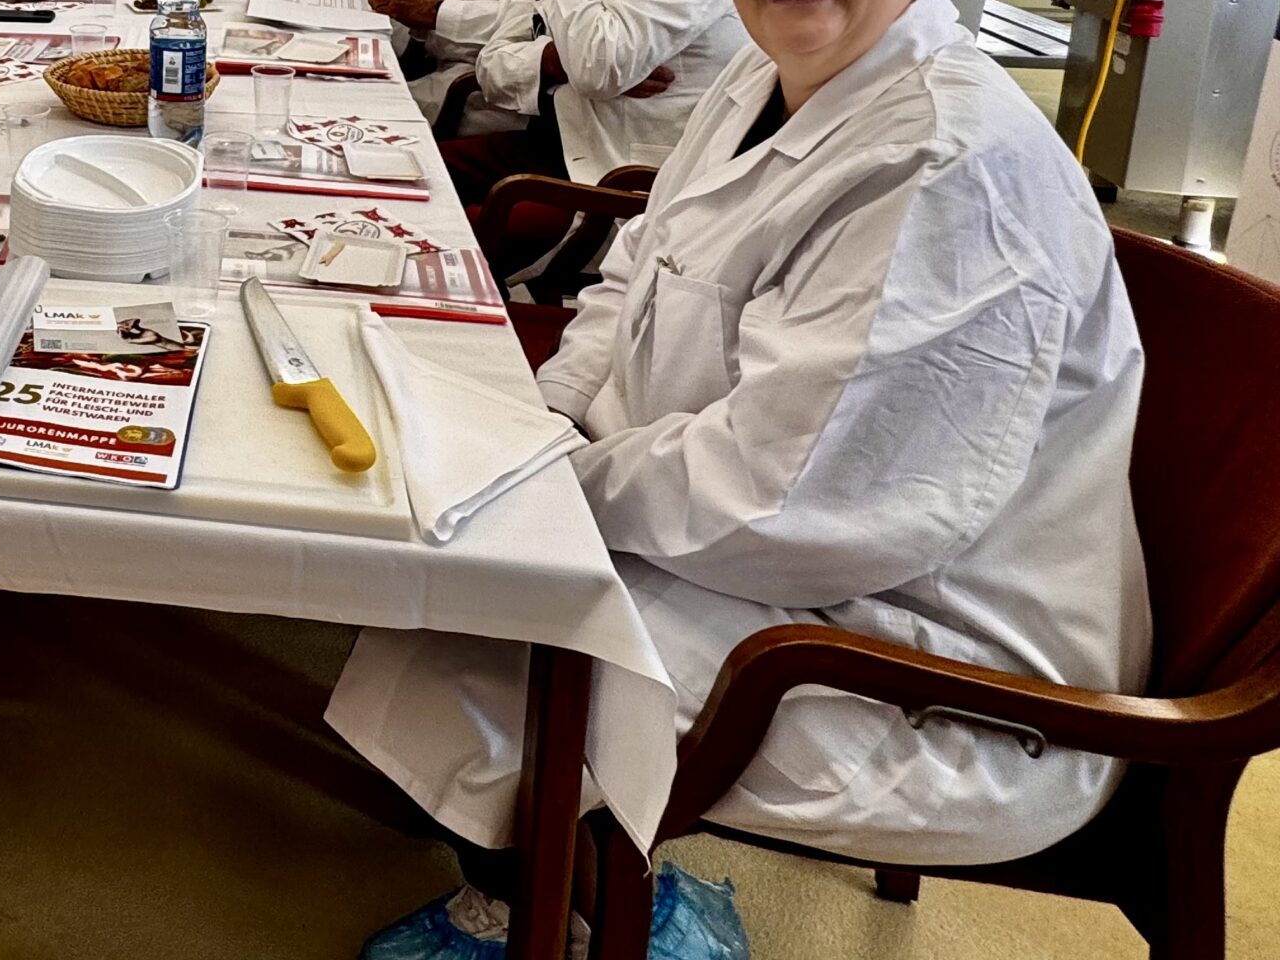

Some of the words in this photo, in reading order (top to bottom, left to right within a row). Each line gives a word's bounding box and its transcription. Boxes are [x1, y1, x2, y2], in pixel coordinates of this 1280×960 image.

[49, 389, 166, 409] FACHWETTBEWERB
[52, 382, 166, 401] INTERNATIONALER
[42, 405, 131, 423] WURSTWAREN
[45, 396, 68, 406] FÜR
[71, 401, 124, 414] FLEISCH-
[126, 408, 154, 417] UND
